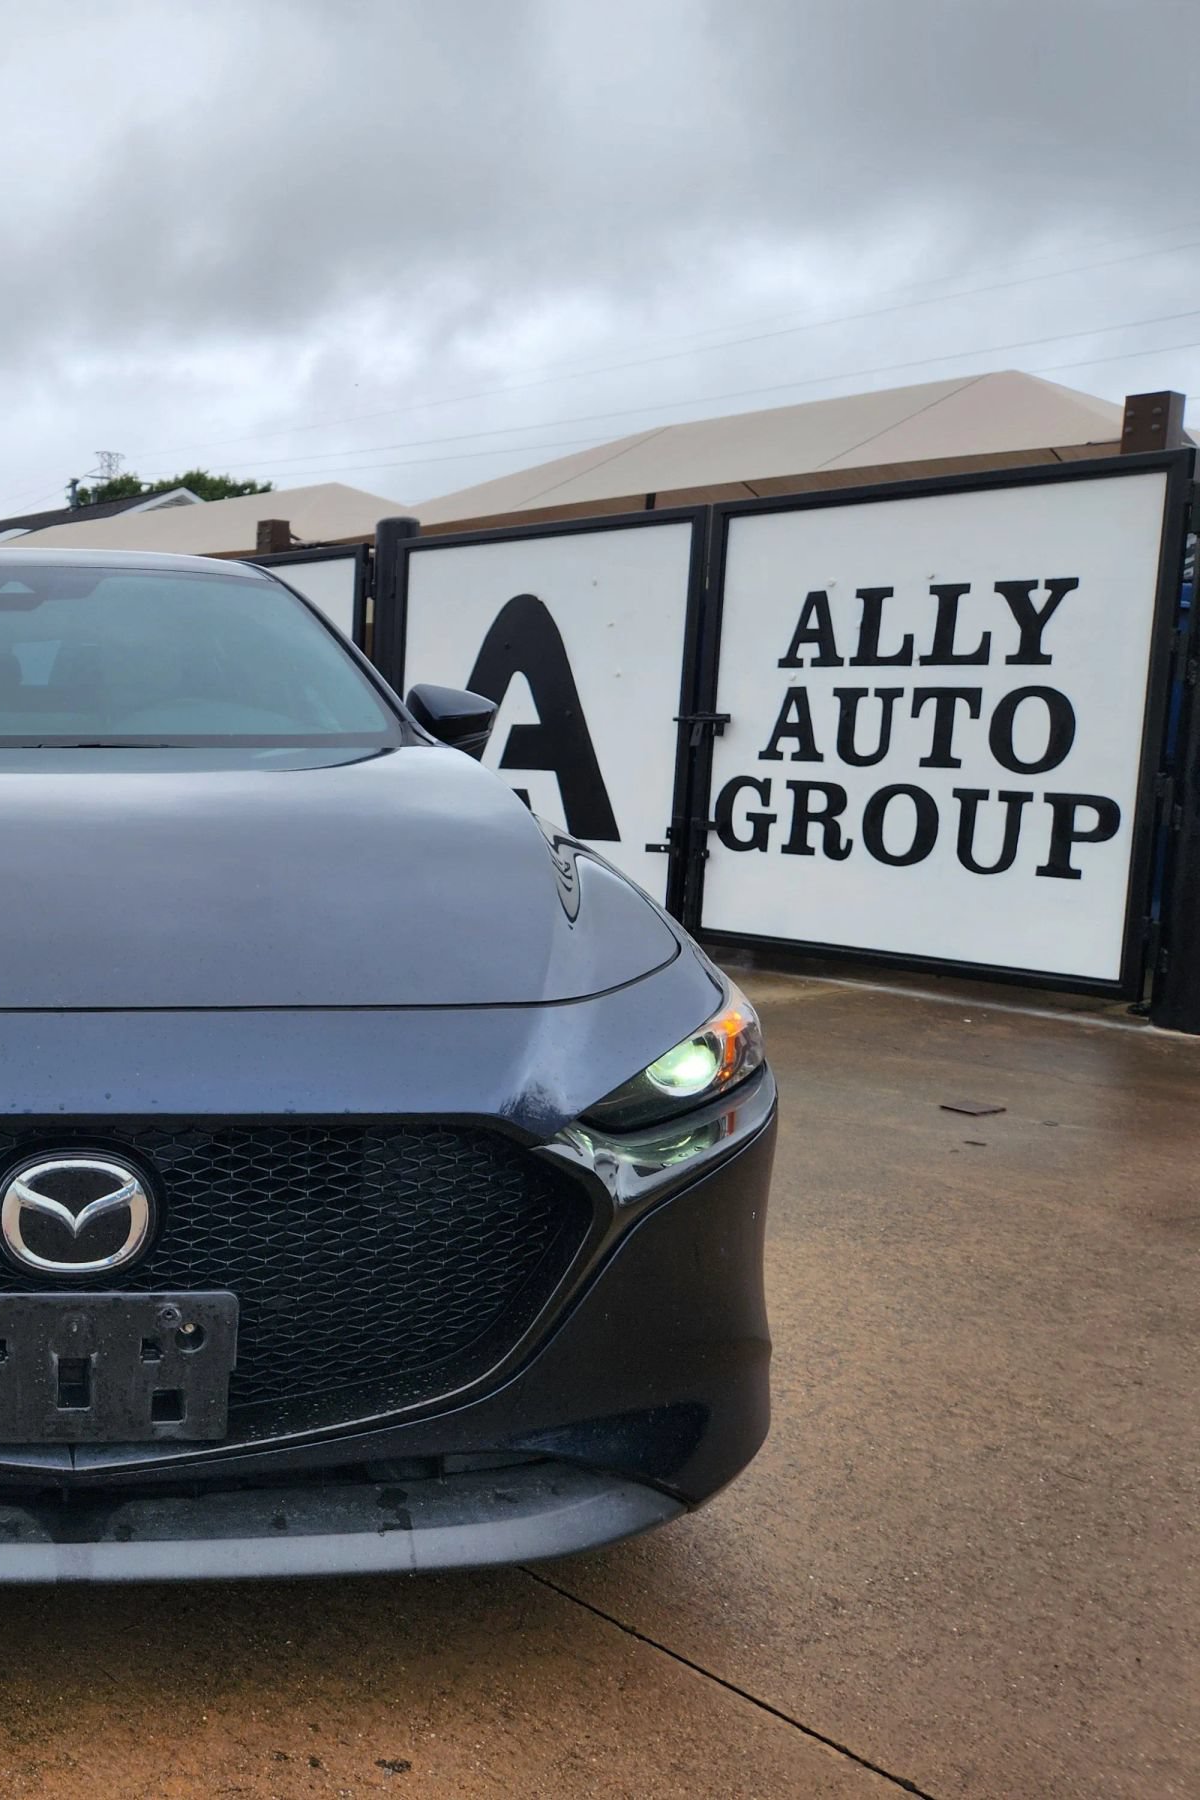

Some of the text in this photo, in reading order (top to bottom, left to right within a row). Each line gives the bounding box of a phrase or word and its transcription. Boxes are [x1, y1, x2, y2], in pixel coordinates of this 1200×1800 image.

[777, 576, 1080, 669] ALLY
[757, 685, 1077, 776] AUTO
[714, 775, 1122, 880] GROUP
